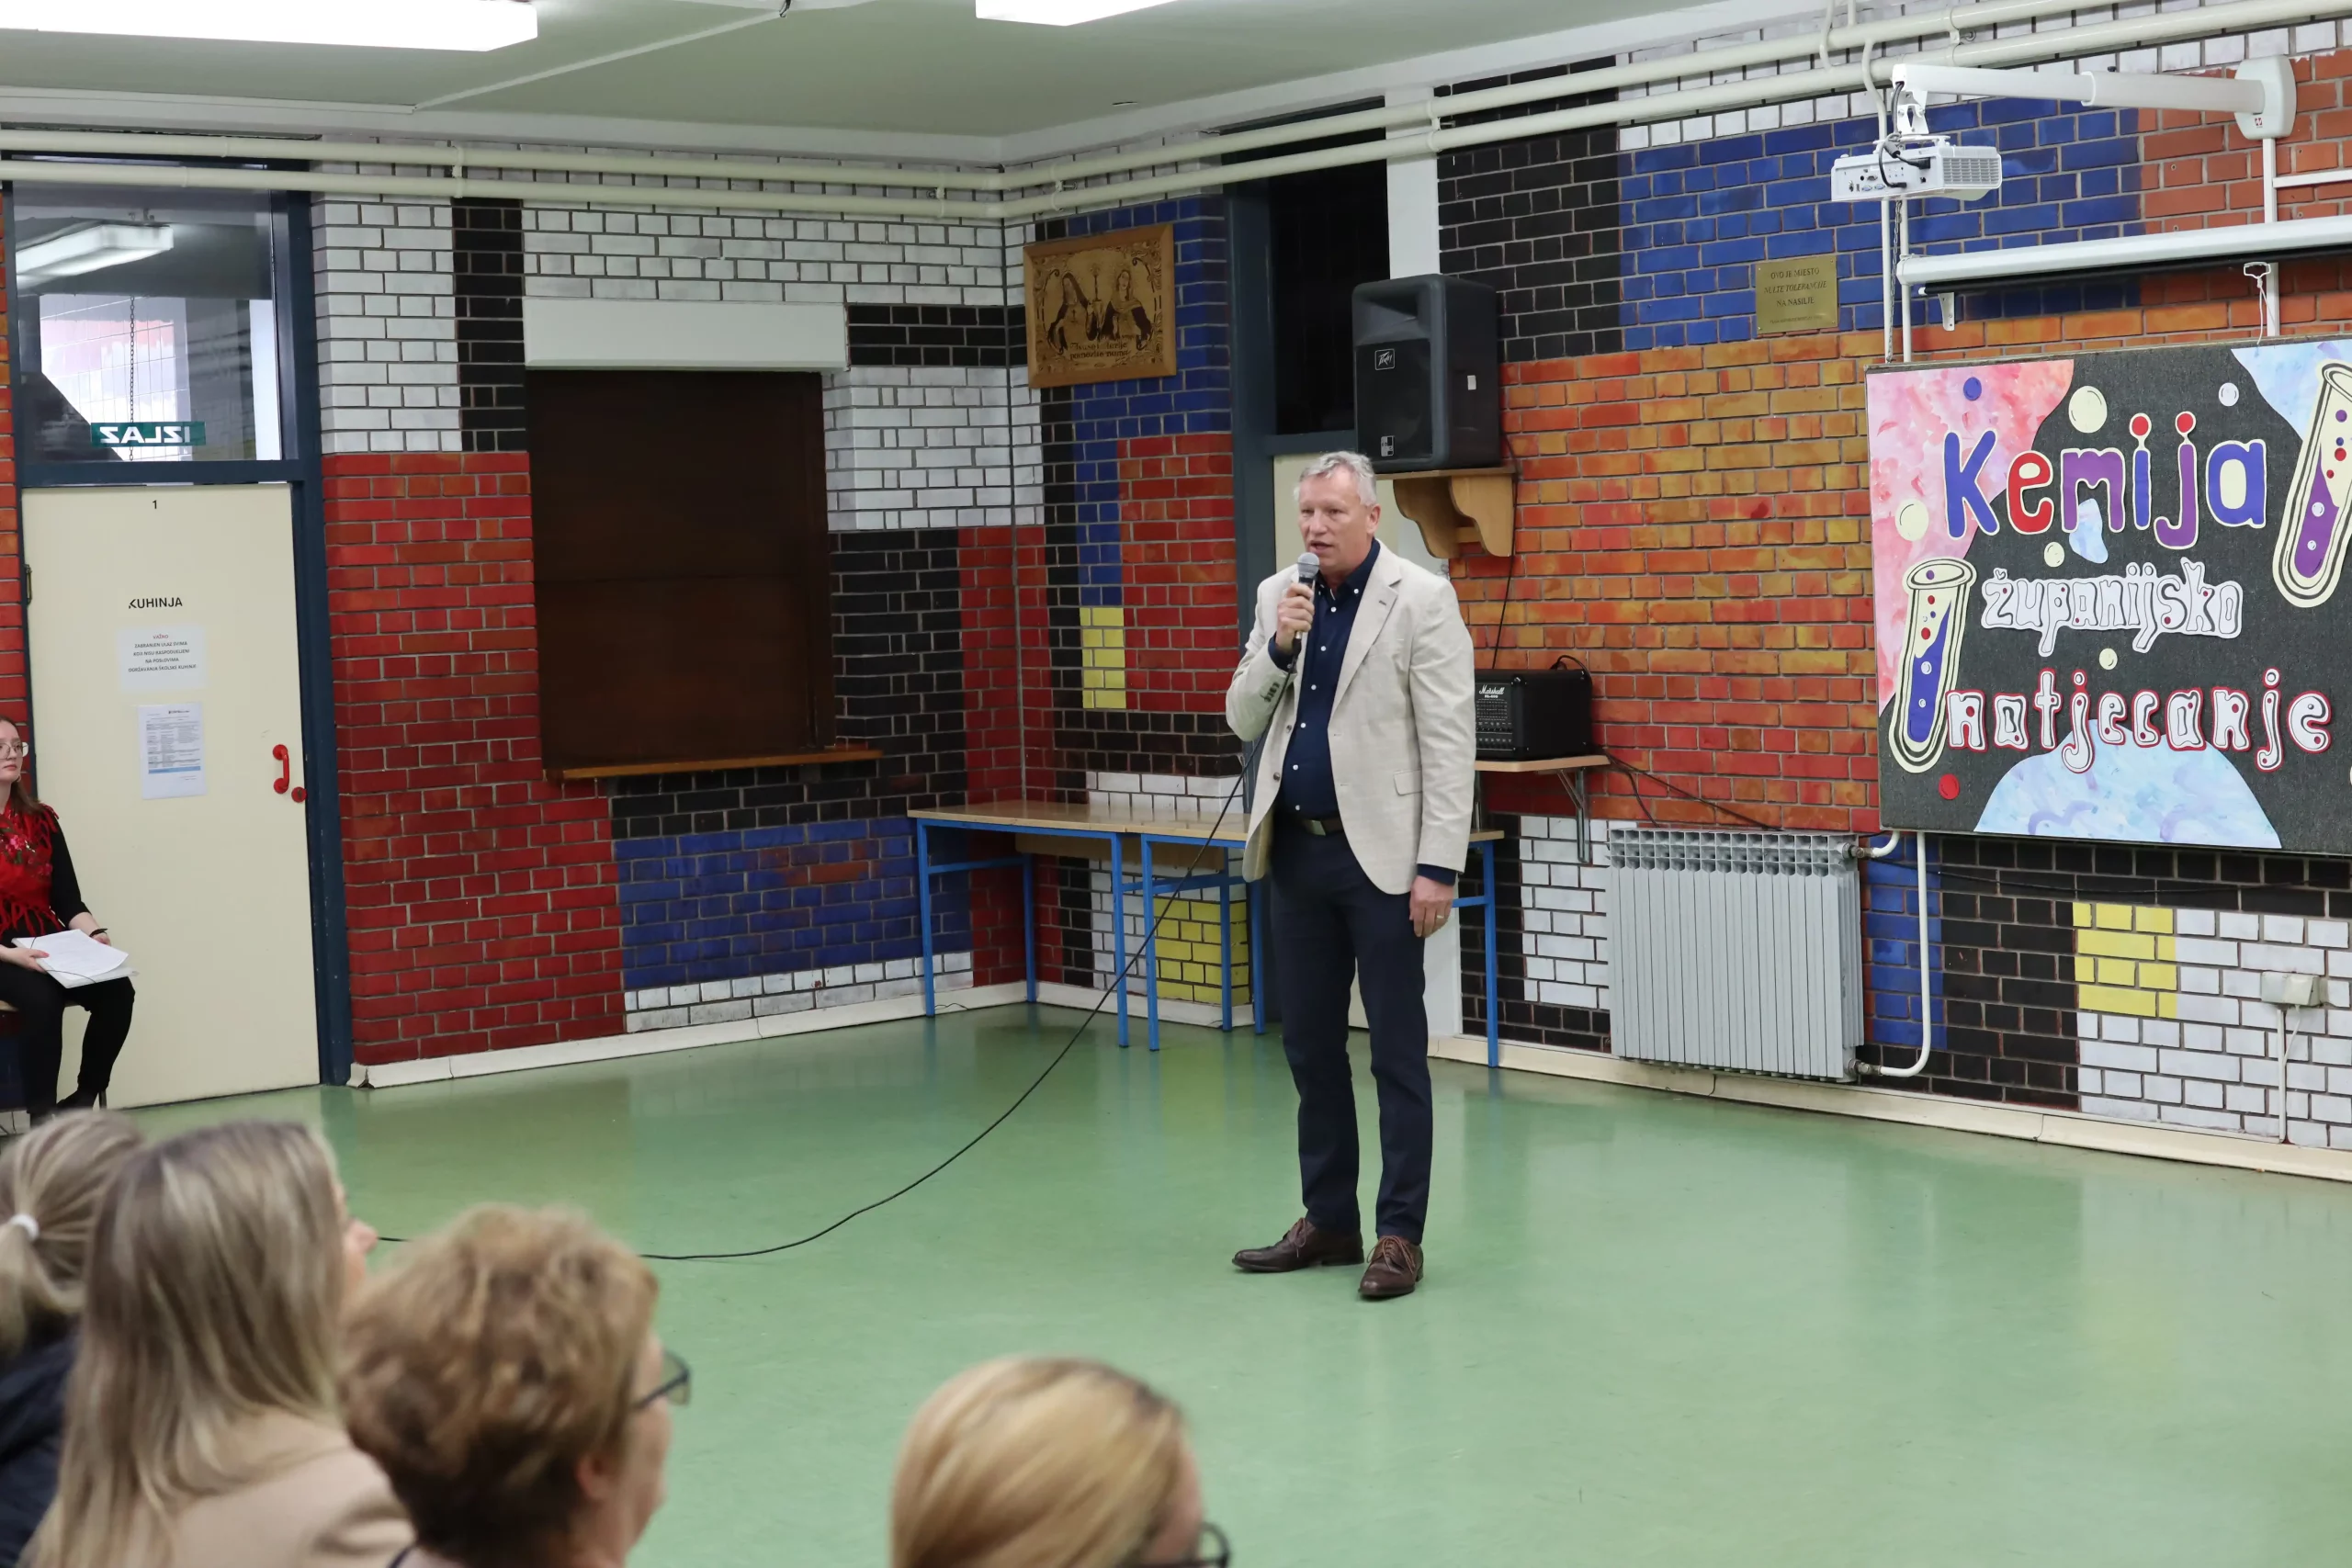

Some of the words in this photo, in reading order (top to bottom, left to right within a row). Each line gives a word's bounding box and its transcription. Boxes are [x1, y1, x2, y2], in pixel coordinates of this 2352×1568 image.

[1770, 271, 1784, 279] OVO
[1793, 267, 1819, 276] MJESTO
[1764, 285, 1785, 294] NULTE
[1785, 280, 1826, 292] TOLERANCIJE
[1776, 299, 1786, 307] NA
[1787, 297, 1815, 306] NASILJE
[1943, 411, 2267, 549] Kemija
[152, 500, 157, 510] 1
[128, 597, 183, 609] KUHINJA
[1981, 557, 2243, 656] županijsko
[1478, 684, 1505, 695] Marshall
[1946, 668, 2332, 773] natjecanje
